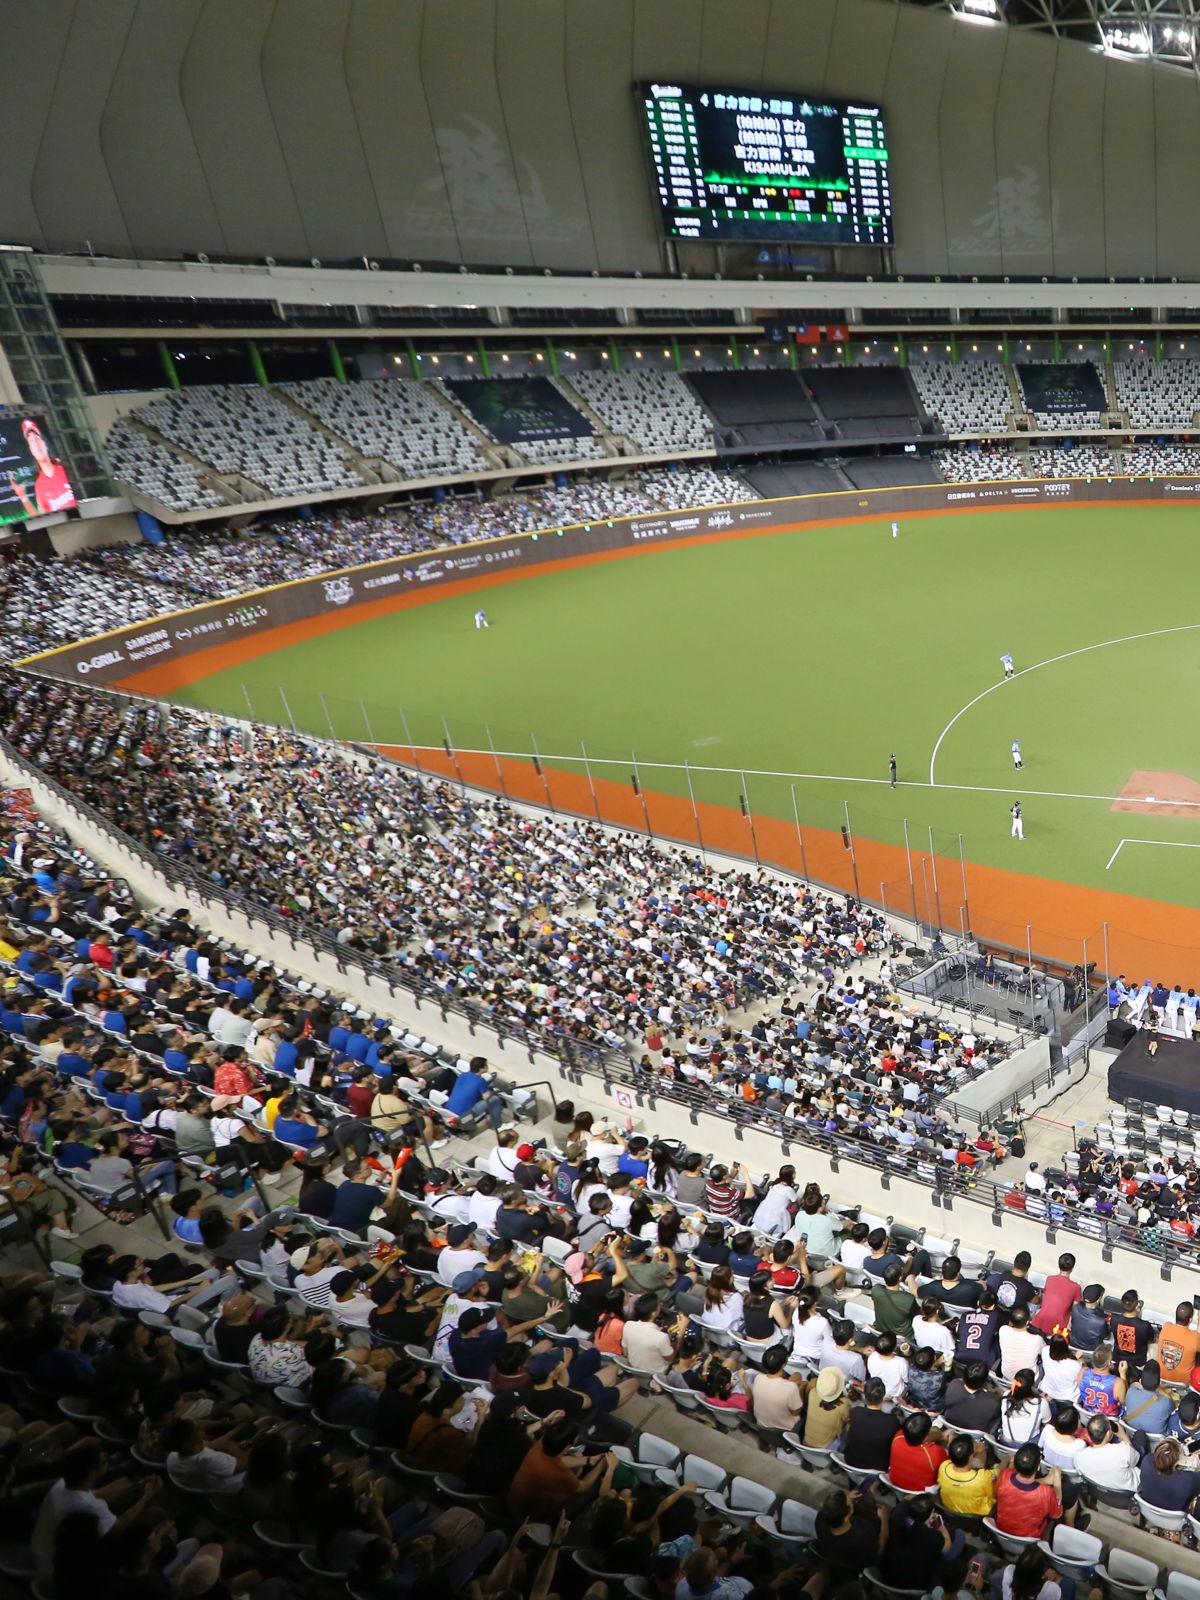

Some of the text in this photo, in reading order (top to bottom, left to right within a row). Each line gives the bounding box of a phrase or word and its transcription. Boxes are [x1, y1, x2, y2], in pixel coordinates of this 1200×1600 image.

[744, 161, 810, 177] KISAMULJA
[1044, 483, 1071, 491] FOOTER
[125, 629, 169, 650] SAMSUNG
[77, 650, 125, 674] O-GRILL
[965, 1313, 990, 1326] CHANG
[966, 1325, 982, 1350] 2
[1085, 1387, 1109, 1410] 23
